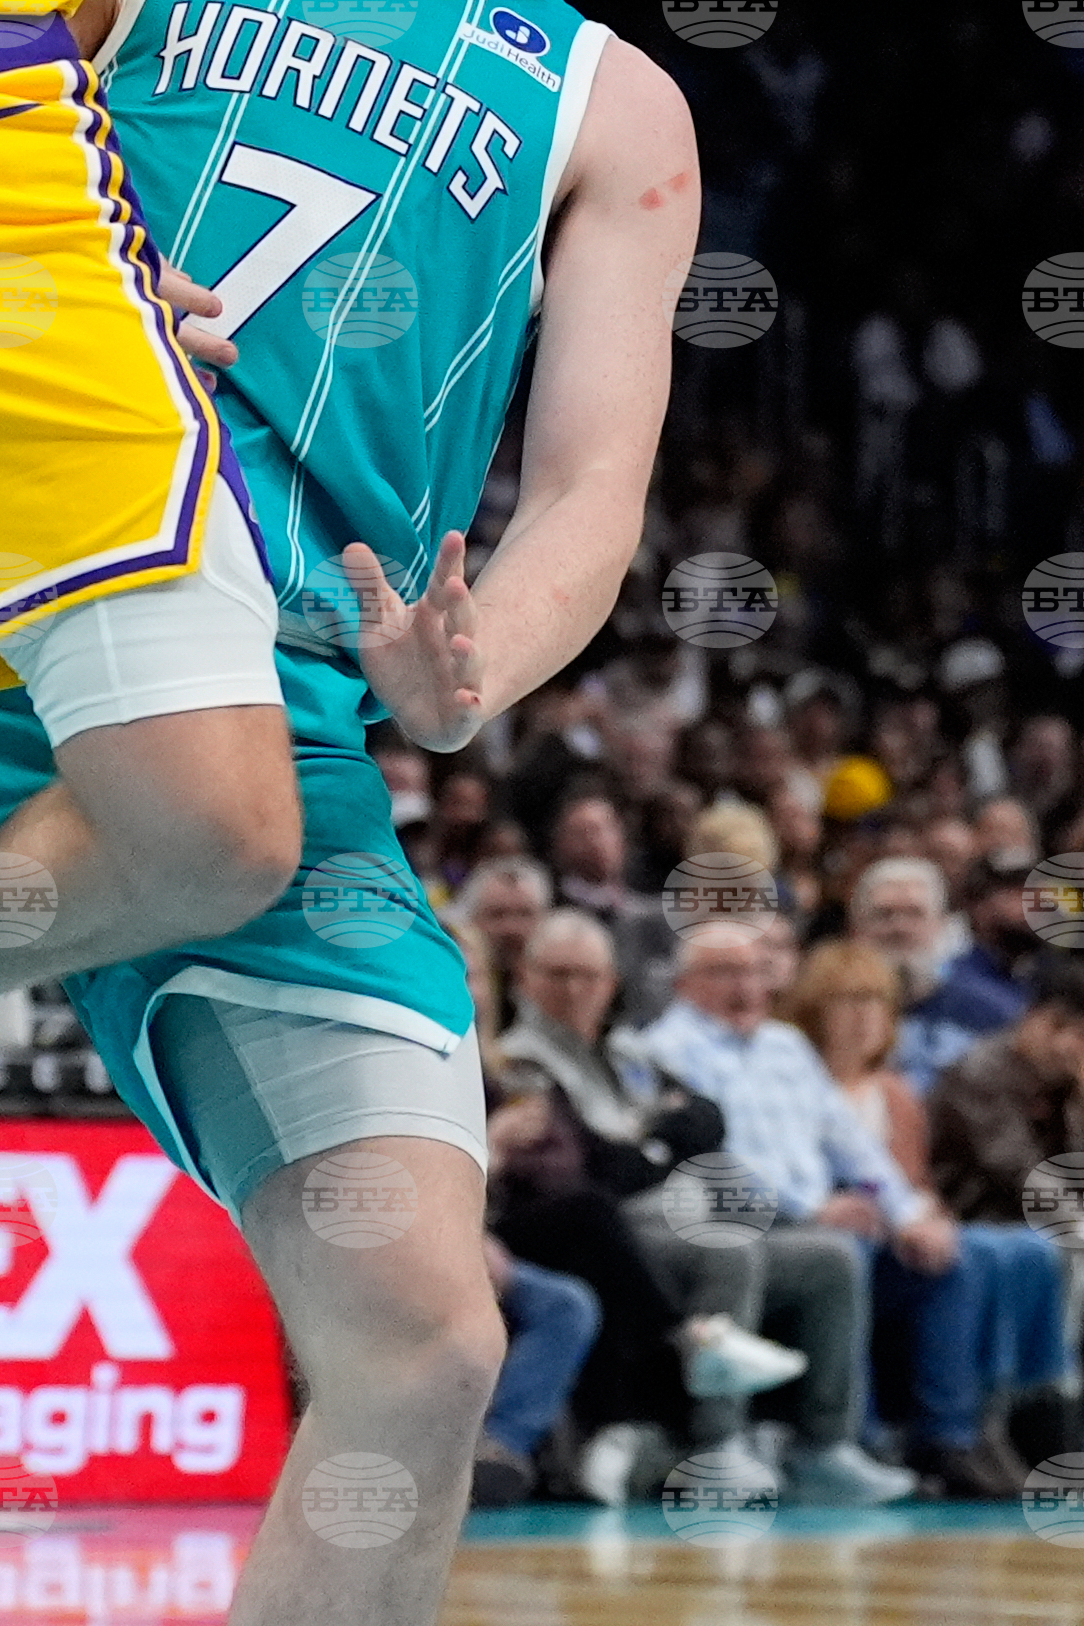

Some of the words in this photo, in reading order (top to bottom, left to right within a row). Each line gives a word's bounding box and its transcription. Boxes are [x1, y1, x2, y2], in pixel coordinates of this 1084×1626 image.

[153, 0, 524, 222] HORNETS
[463, 30, 505, 53] Judi
[507, 48, 557, 89] Health
[180, 140, 383, 341] 7
